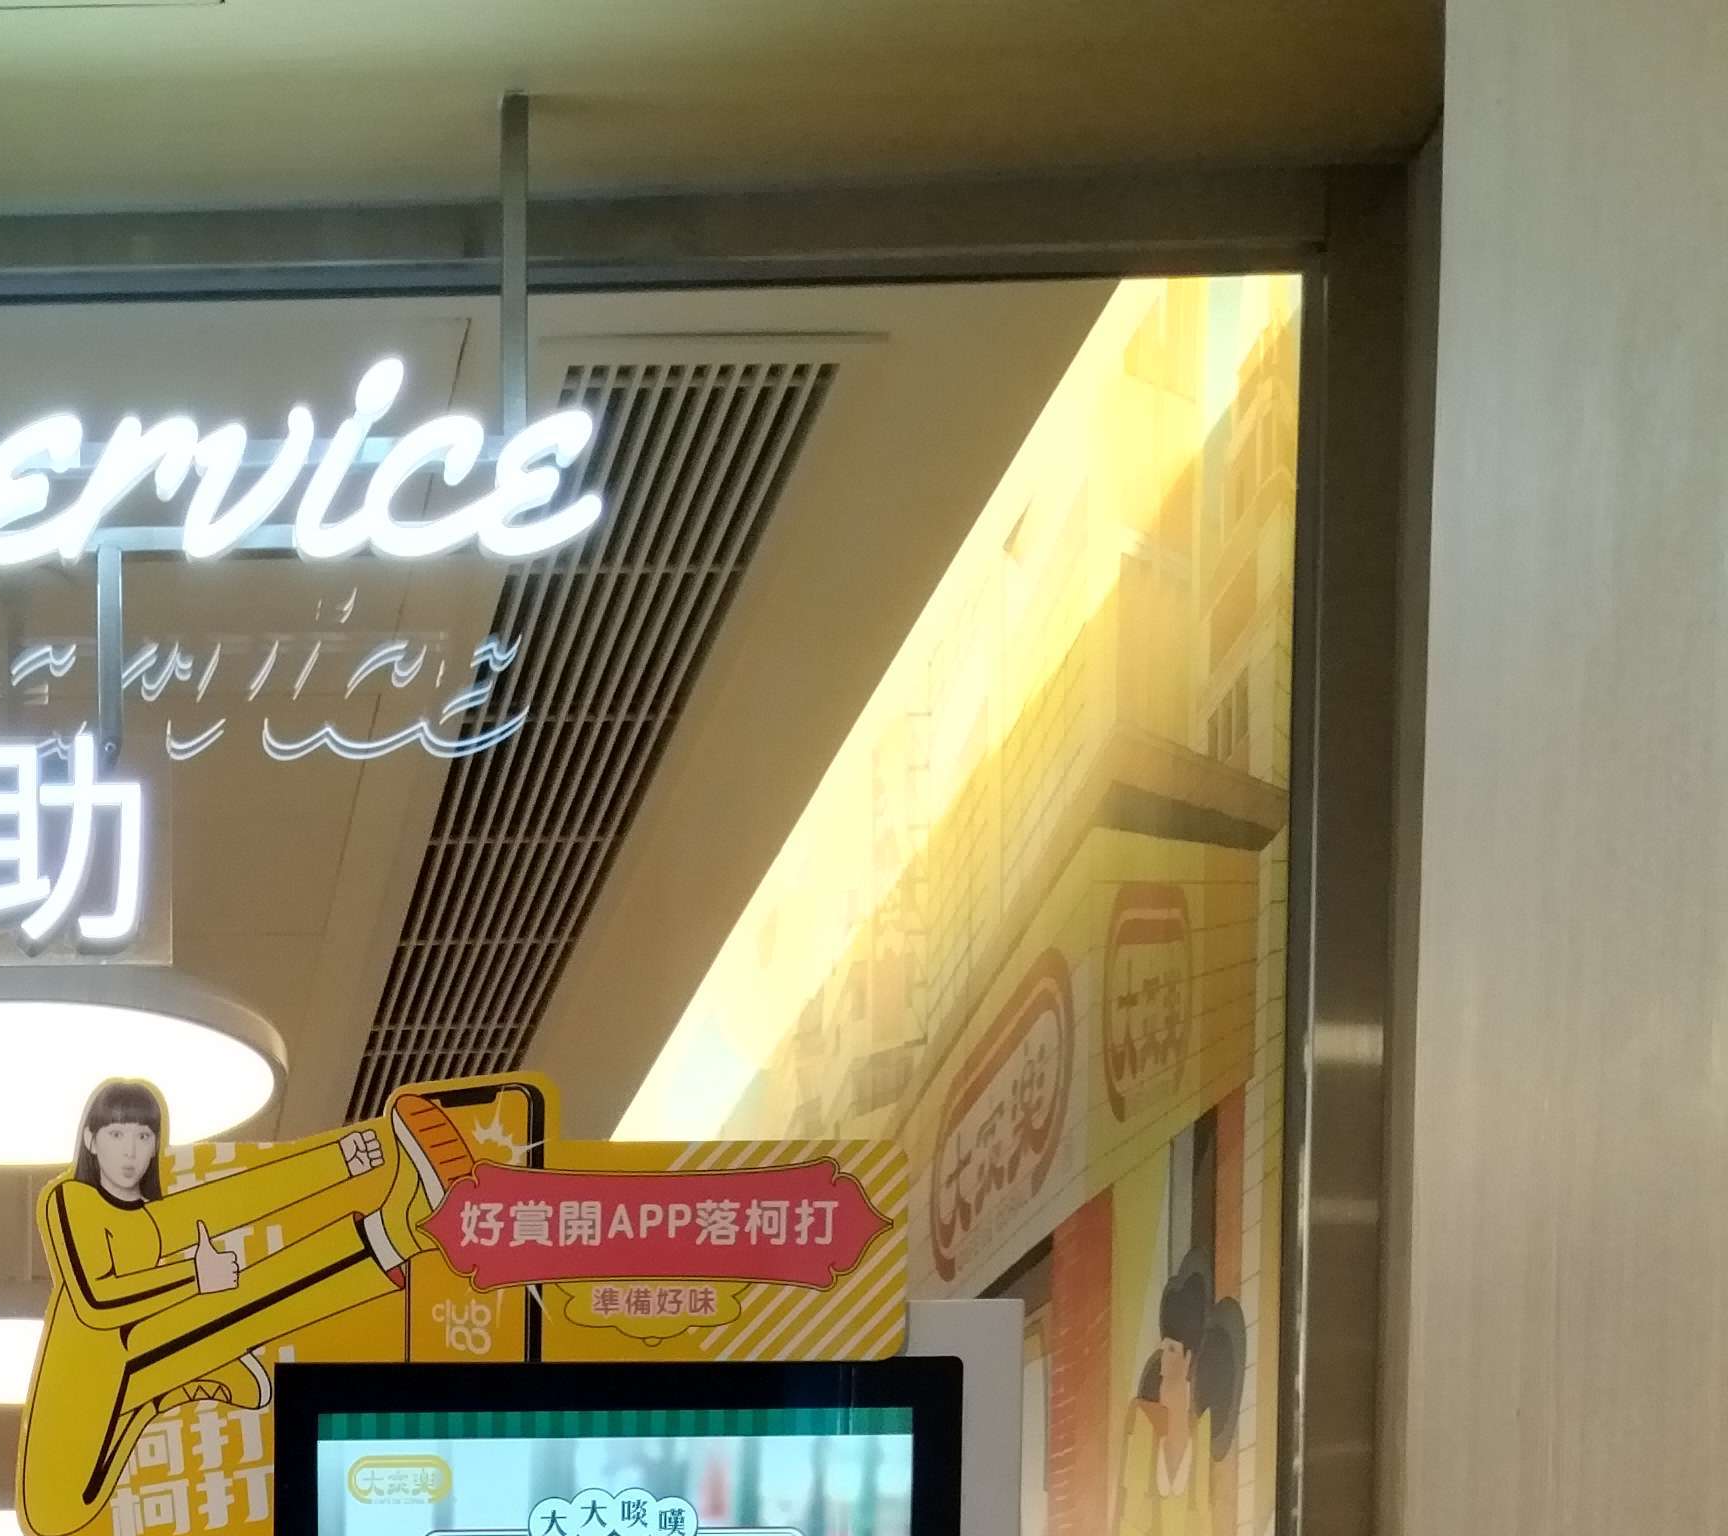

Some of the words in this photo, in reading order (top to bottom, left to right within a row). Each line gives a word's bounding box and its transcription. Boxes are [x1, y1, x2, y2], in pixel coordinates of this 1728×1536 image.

[459, 1196, 839, 1250] 好賞開APP落柯打
[431, 1297, 493, 1328] club
[592, 1286, 717, 1318] 準備好味
